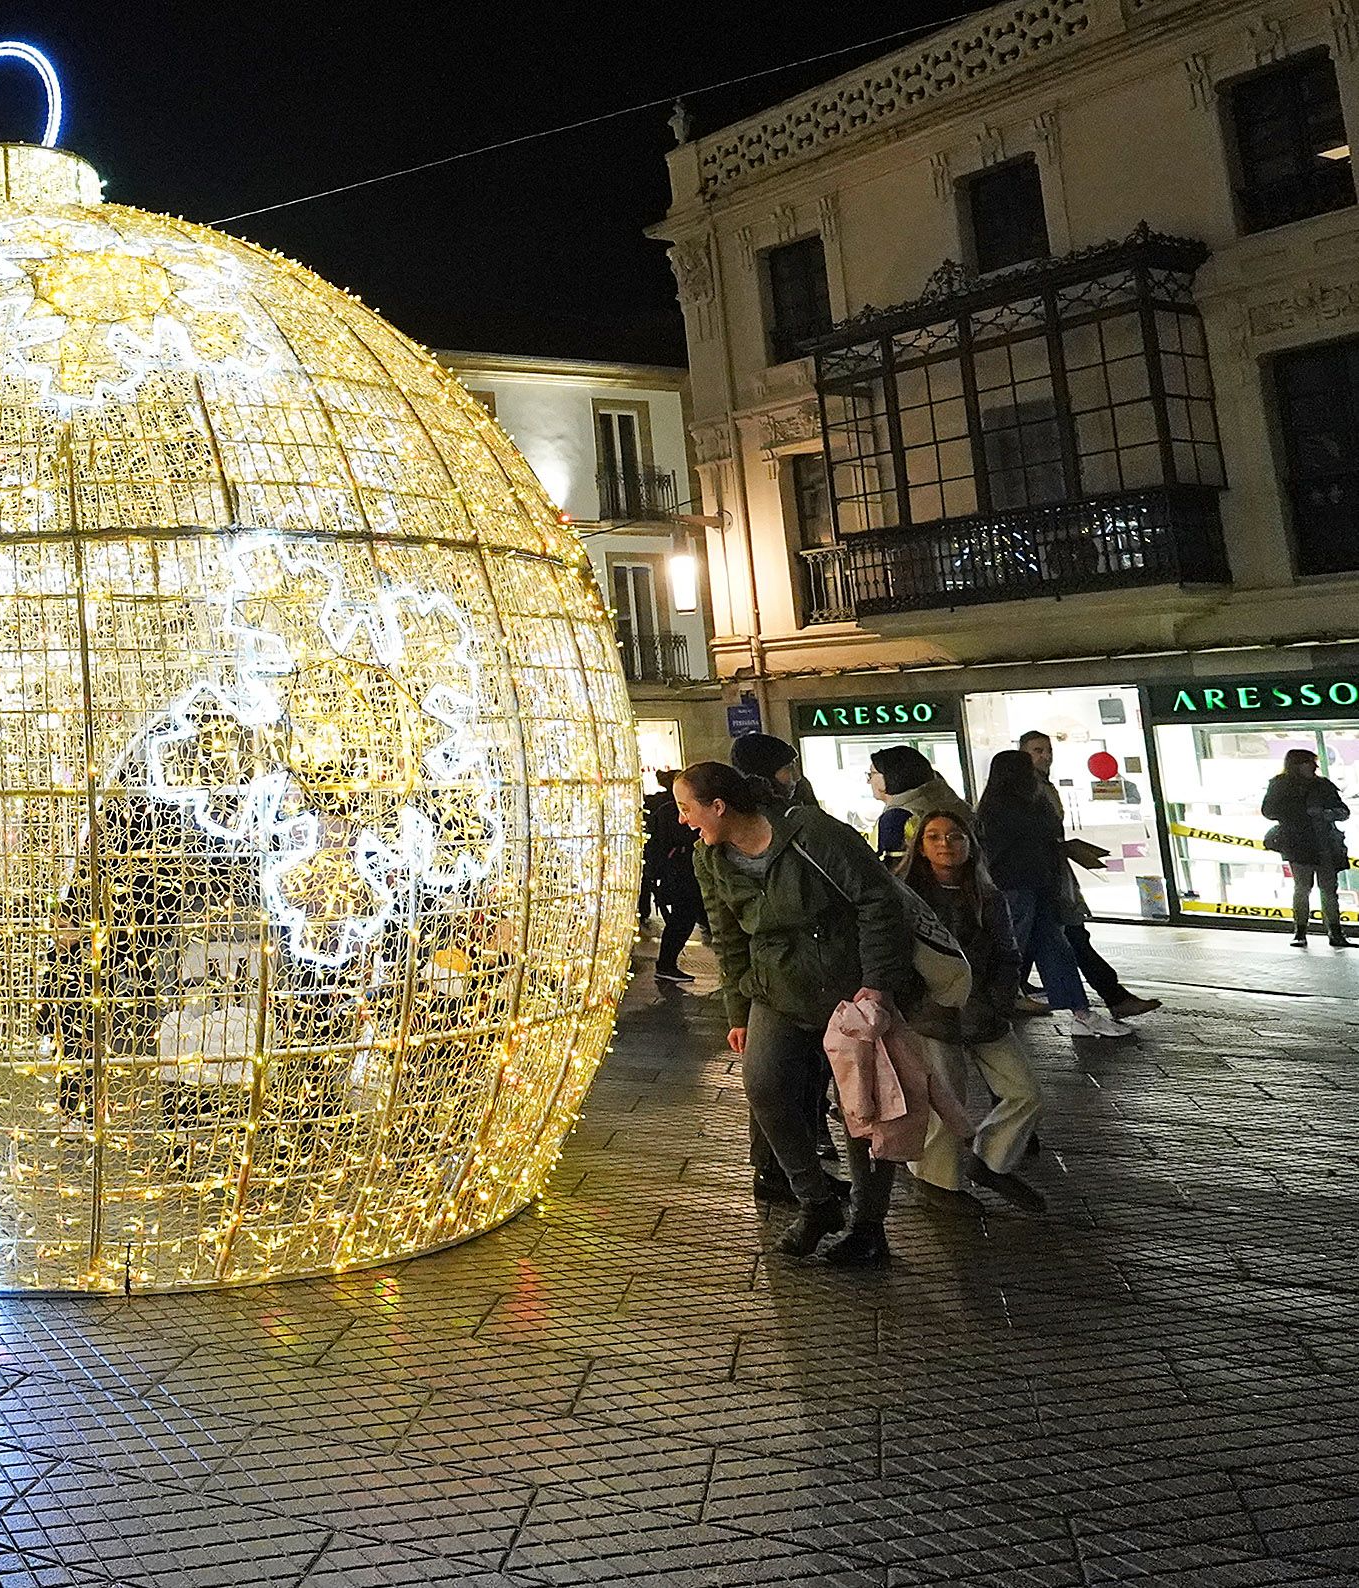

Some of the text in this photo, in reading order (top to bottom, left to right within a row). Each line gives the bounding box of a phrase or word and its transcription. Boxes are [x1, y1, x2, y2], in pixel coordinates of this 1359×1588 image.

[1173, 682, 1359, 712] ARESSO
[812, 703, 933, 726] ARESSO
[1188, 827, 1255, 848] ¡HASTA
[1215, 902, 1283, 918] ¡HASTA
